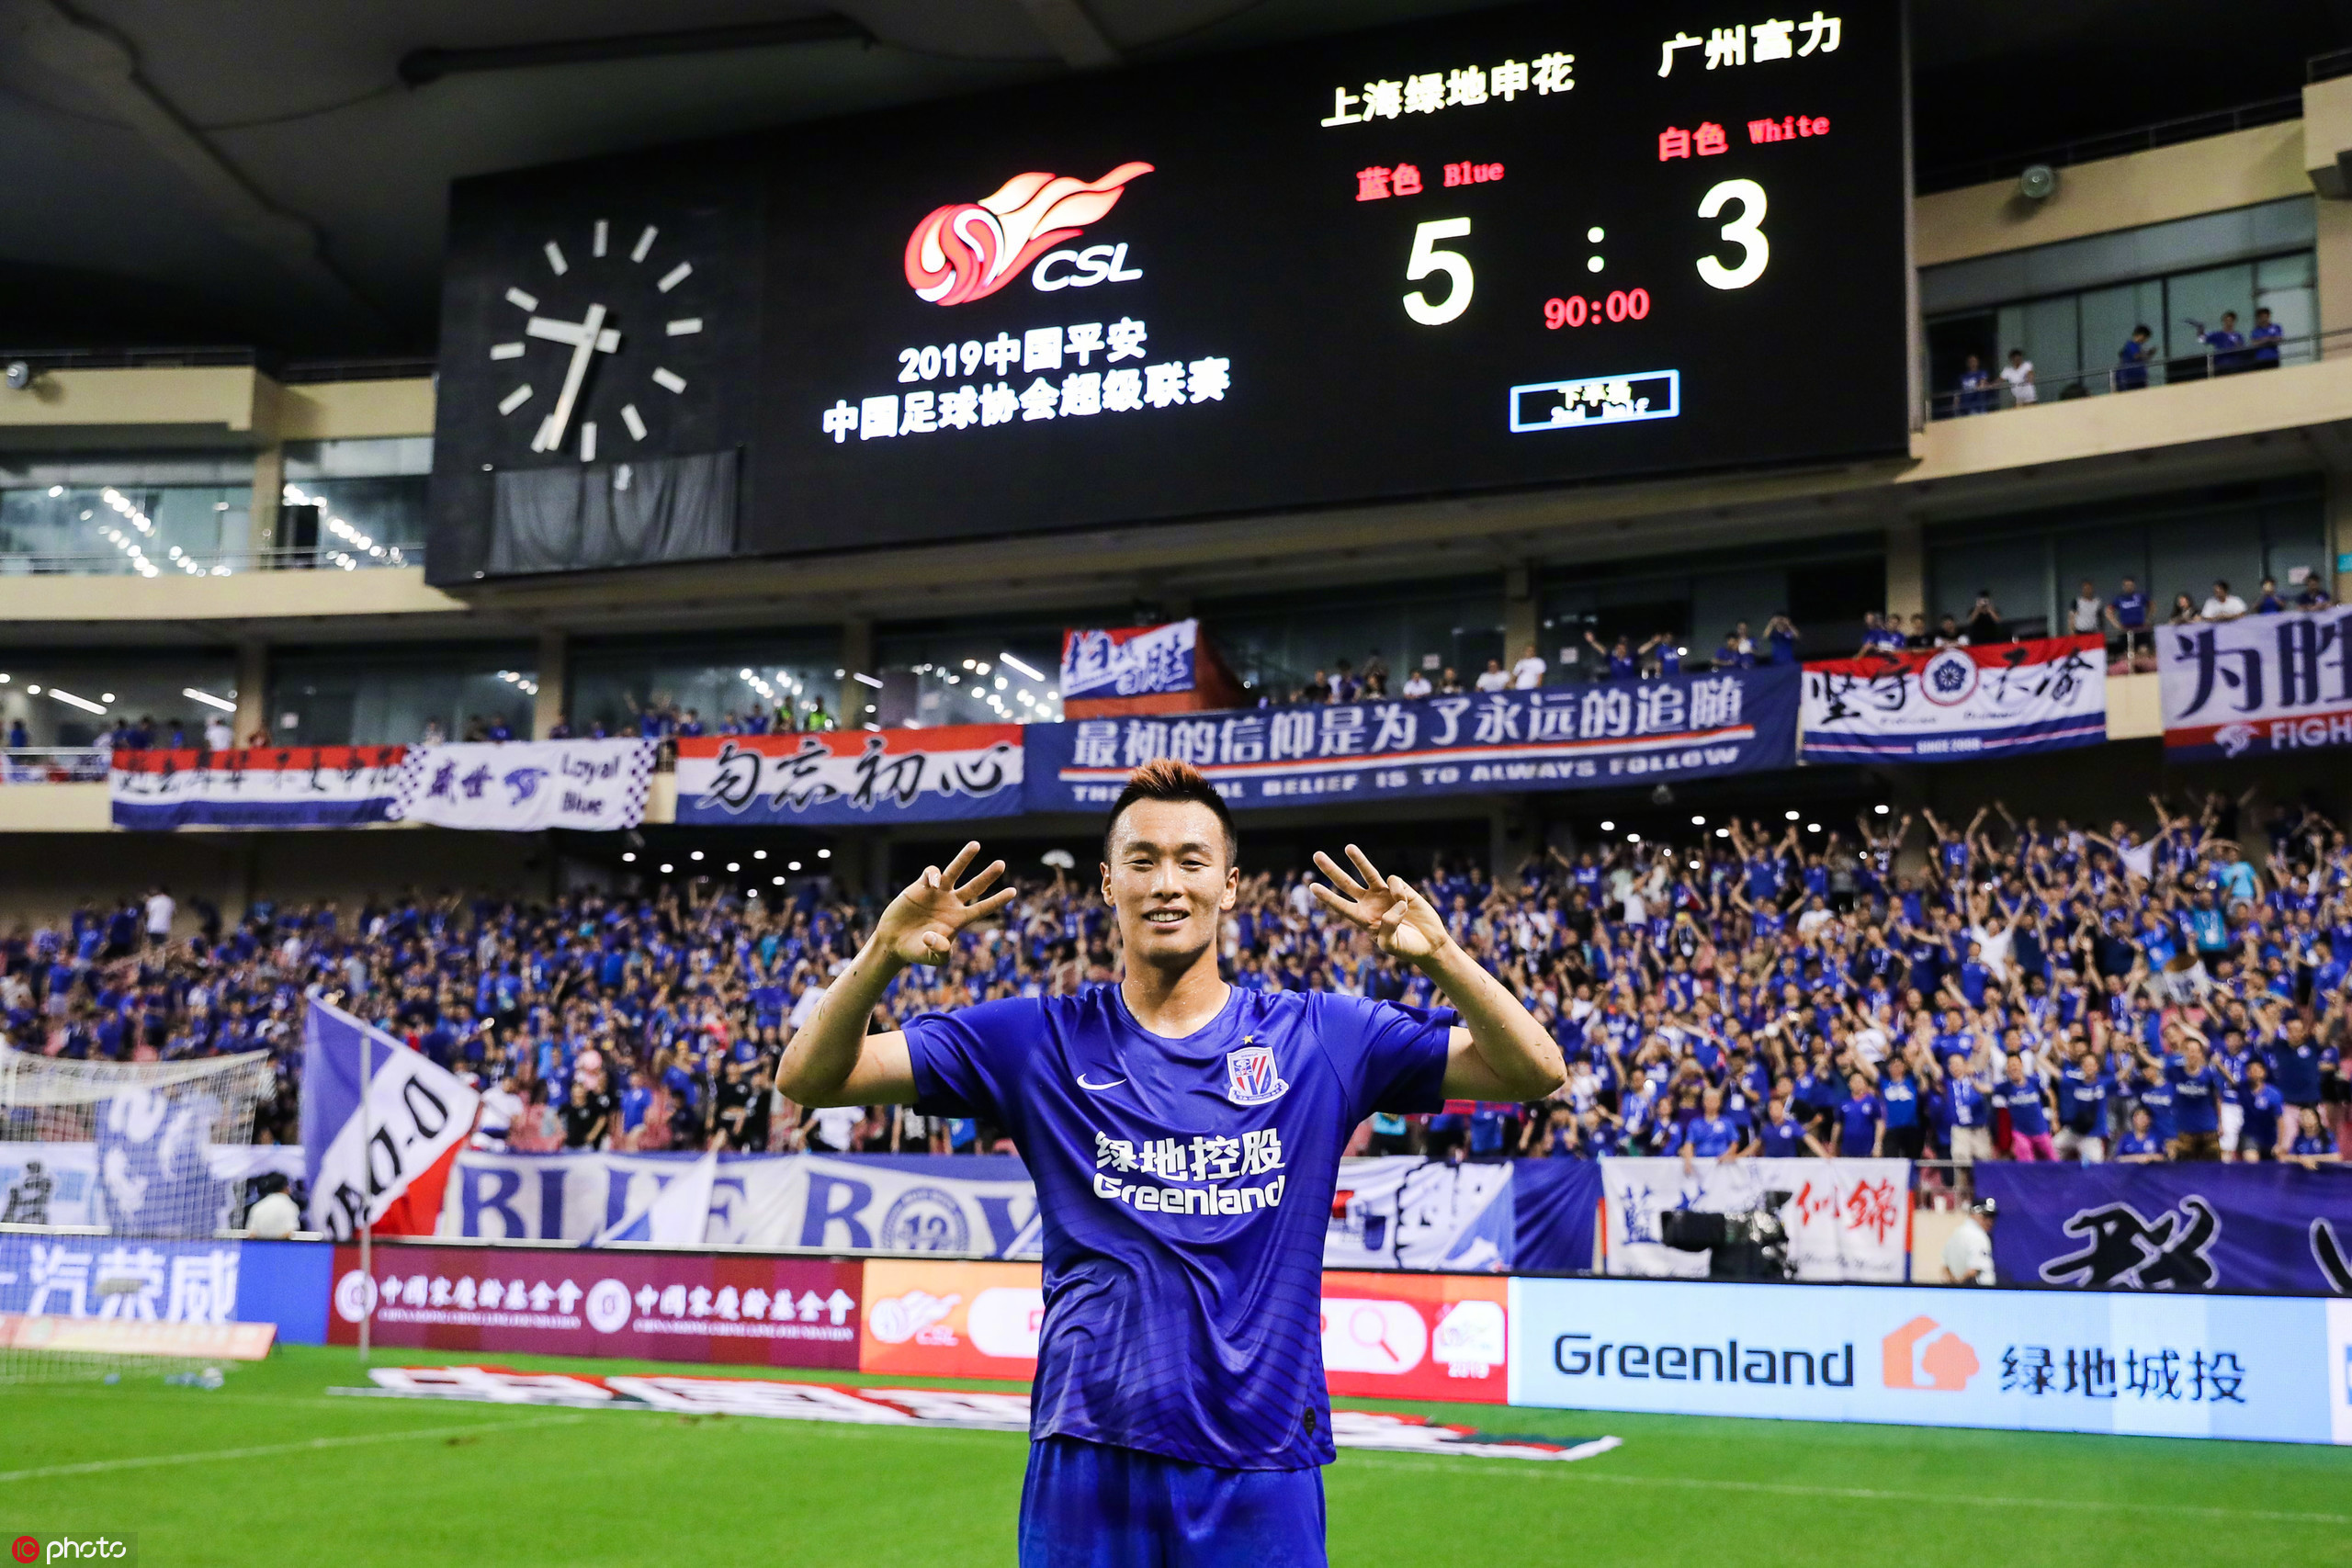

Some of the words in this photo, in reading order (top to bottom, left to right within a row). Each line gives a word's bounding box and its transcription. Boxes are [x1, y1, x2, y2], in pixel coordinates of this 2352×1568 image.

[1657, 10, 1841, 77] 广州富力
[1320, 51, 1576, 127] 上海绿地申花
[1658, 121, 1728, 161] 白色
[1747, 114, 1830, 145] White
[1355, 162, 1423, 201] 蓝色
[1443, 160, 1505, 187] Blue
[1032, 243, 1143, 292] CSL
[1402, 216, 1475, 326] 5
[1695, 178, 1770, 290] 3
[1544, 288, 1650, 331] 90:00
[898, 316, 1148, 384] 2019中国平安
[822, 356, 1231, 444] 中国足球协会超级联赛
[1072, 675, 1744, 766] 最初的信仰是为了永远的追随
[1262, 774, 1359, 797] BELIEF
[1375, 770, 1408, 788] IS
[1420, 765, 1461, 784] TO
[1470, 760, 1597, 783] ALWAYS
[1610, 746, 1739, 775] FOLLOW
[1094, 1127, 1286, 1182] 绿地控股
[1092, 1172, 1286, 1216] Greenland
[1555, 1334, 1854, 1387] Greenland
[2000, 1344, 2245, 1404] 绿地城投
